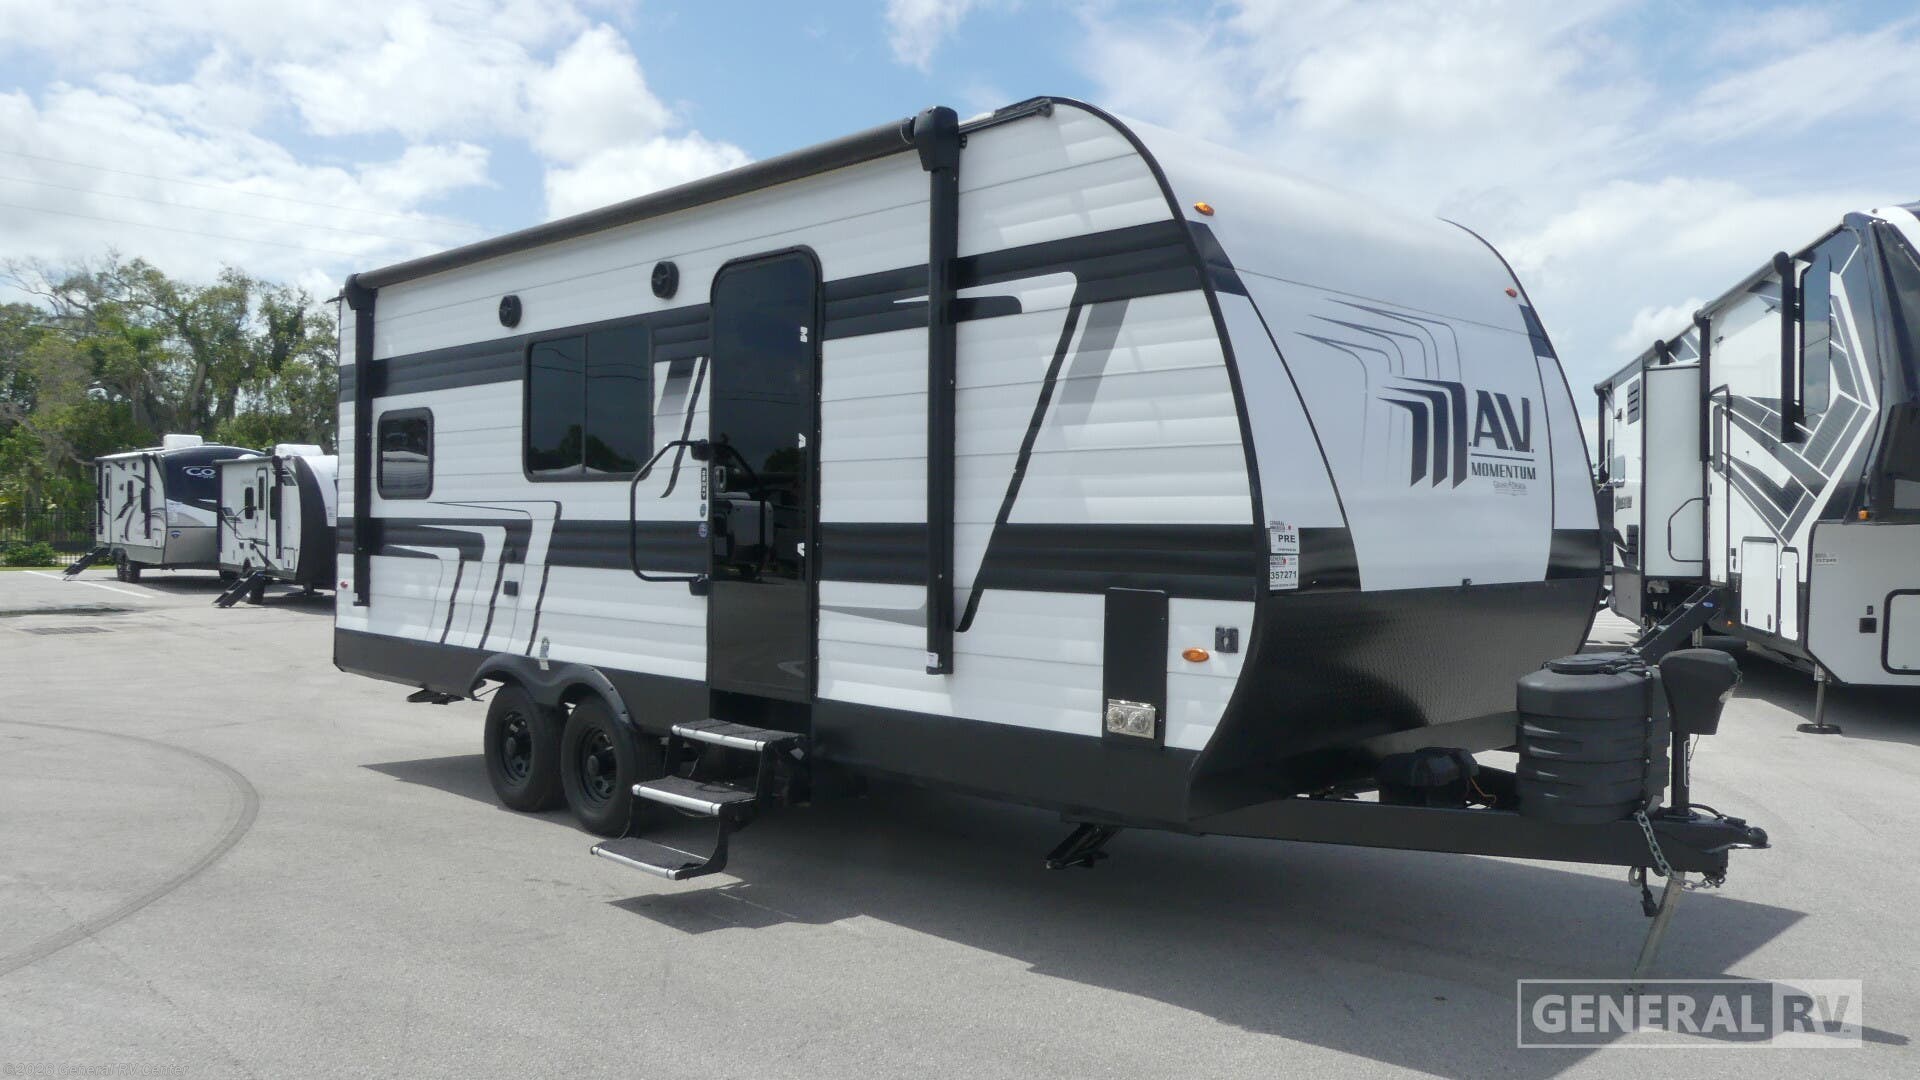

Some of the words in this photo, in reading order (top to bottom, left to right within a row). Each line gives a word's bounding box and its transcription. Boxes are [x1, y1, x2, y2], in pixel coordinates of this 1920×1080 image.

[1471, 461, 1536, 480] MOMENTUM
[1278, 534, 1296, 543] PRE
[1270, 570, 1297, 580] 357271
